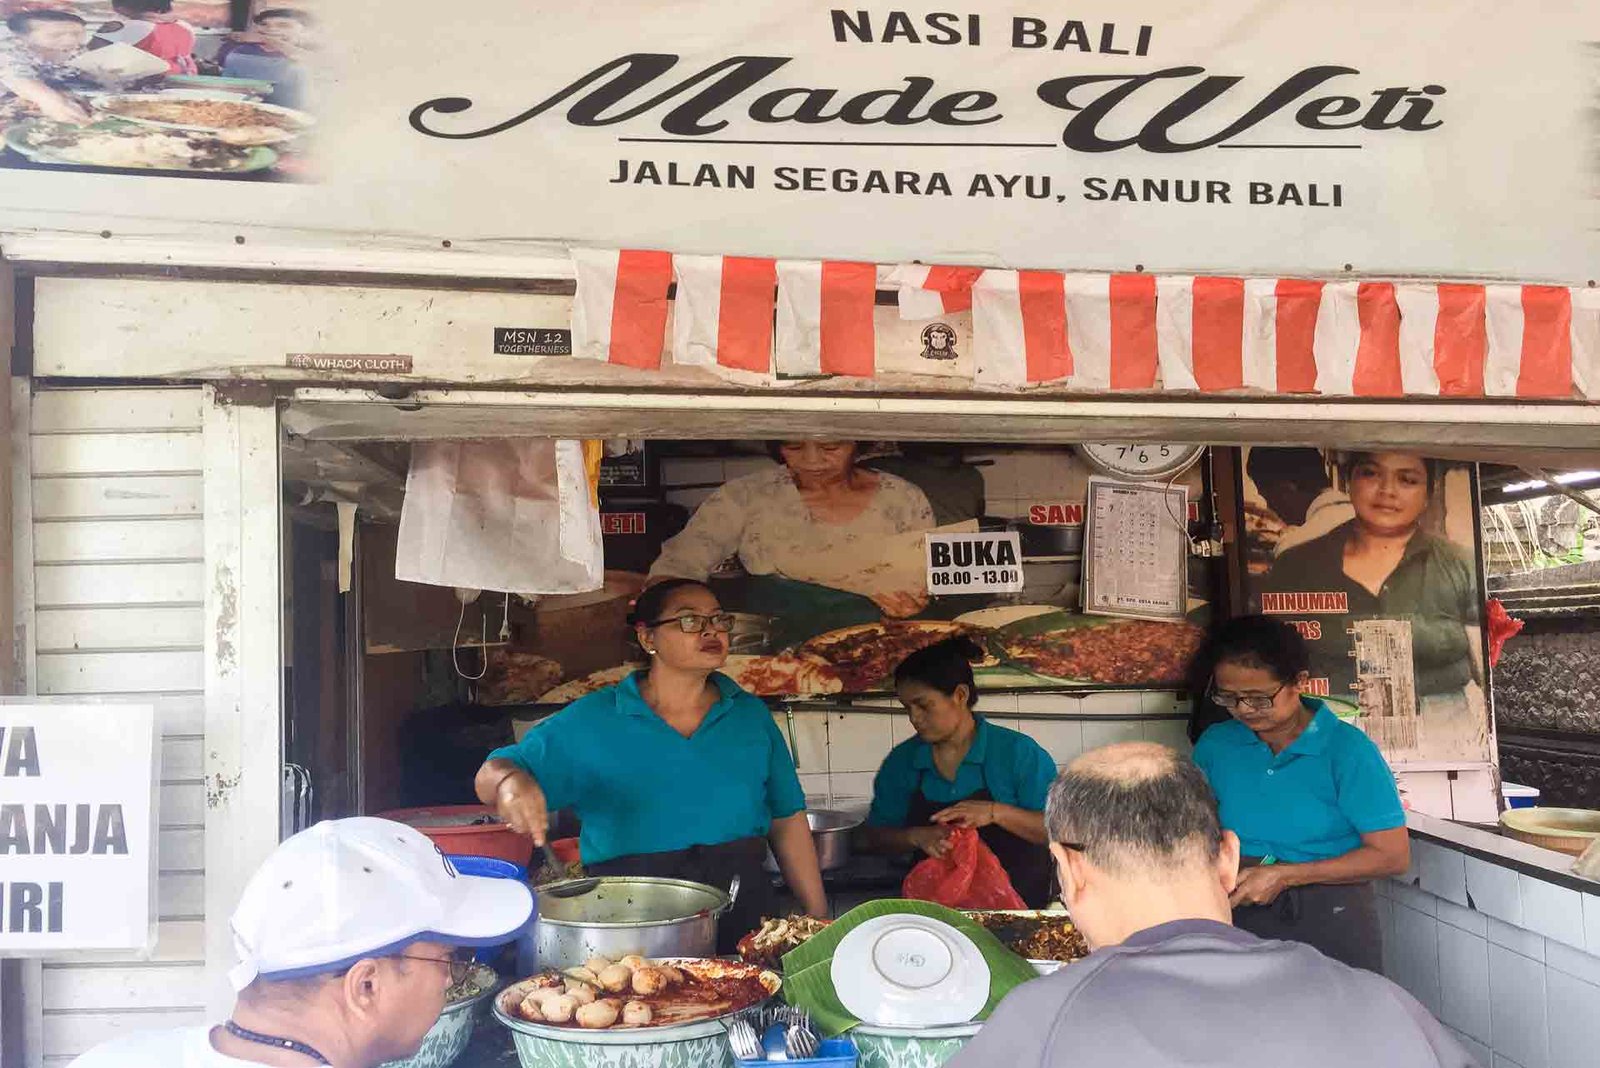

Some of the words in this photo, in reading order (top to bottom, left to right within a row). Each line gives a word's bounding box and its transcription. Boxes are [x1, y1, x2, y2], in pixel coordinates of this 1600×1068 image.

[831, 10, 980, 45] NASI
[1012, 17, 1152, 56] BALI
[409, 54, 1003, 140] Made
[1037, 66, 1447, 153] Weti
[609, 159, 754, 188] JALAN
[774, 167, 952, 196] SEGARA
[967, 173, 1066, 203] AYU,
[1083, 178, 1231, 204] SANUR
[1249, 182, 1342, 206] BALI
[503, 331, 537, 343] MSN
[544, 332, 563, 343] 12
[498, 344, 570, 354] TOGETHERNESS
[313, 359, 362, 369] WHACK
[1116, 446, 1126, 459] 7
[1139, 450, 1149, 463] 6
[1160, 444, 1170, 457] 5
[600, 513, 646, 534] ETI
[1028, 503, 1087, 525] SAN
[930, 540, 1017, 567] BUKA
[932, 571, 971, 585] 08.00
[982, 570, 1018, 584] 13.00
[1262, 592, 1348, 613] MINUMAN
[0, 804, 129, 854] ANJA
[0, 882, 63, 932] RI
